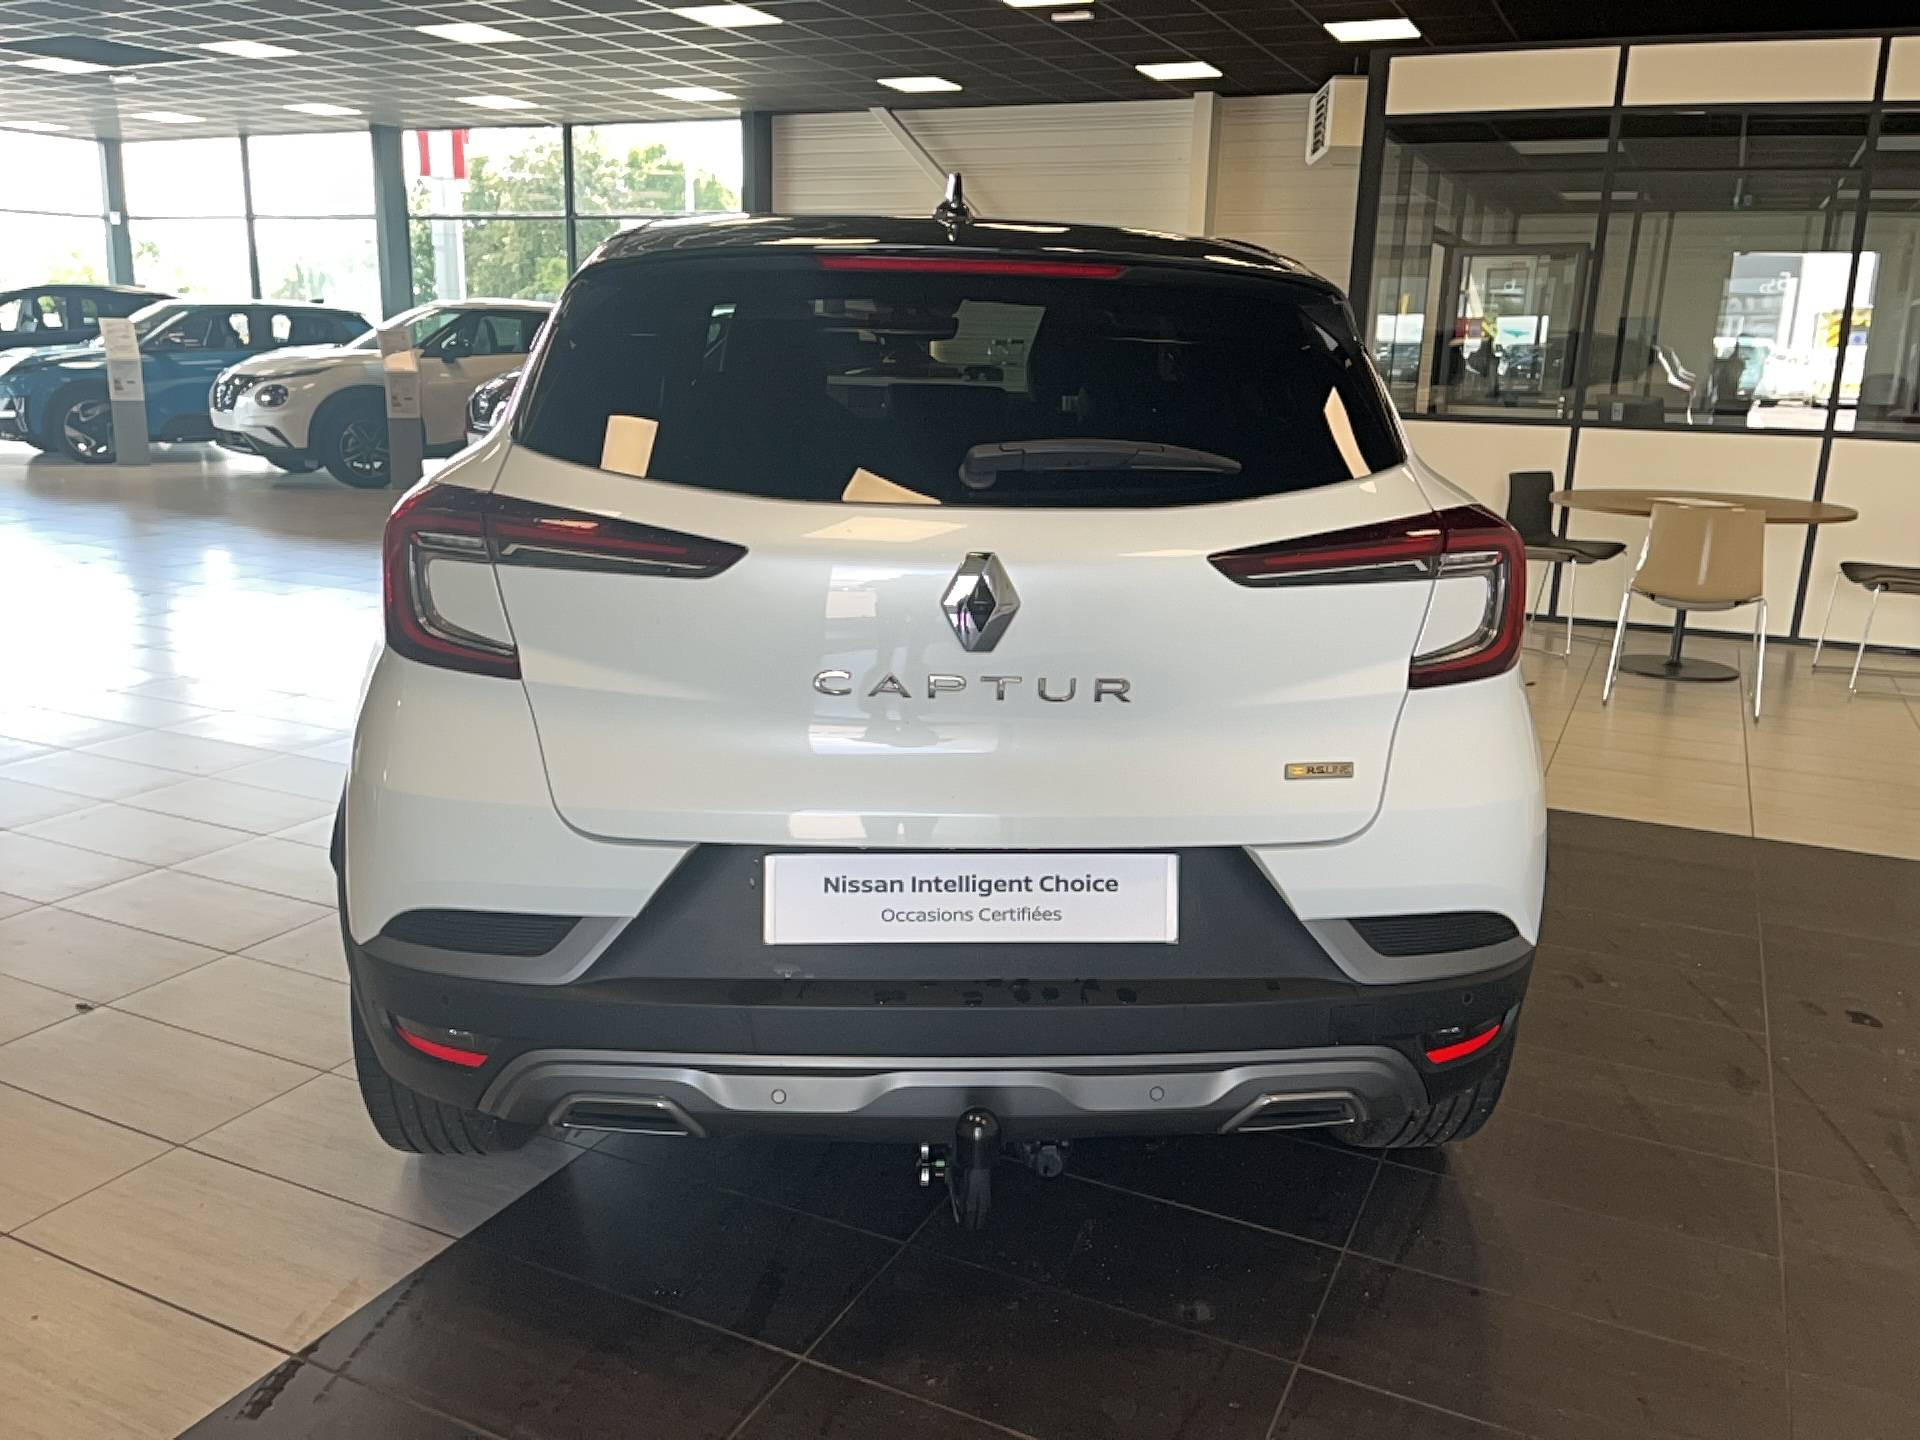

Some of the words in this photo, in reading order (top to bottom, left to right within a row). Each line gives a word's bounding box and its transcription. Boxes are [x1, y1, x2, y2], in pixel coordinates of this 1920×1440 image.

[812, 670, 1131, 703] CAPTUR
[823, 875, 904, 893] Nissan
[911, 874, 1033, 897] Intelligent
[1038, 874, 1119, 893] Choice
[881, 907, 973, 923] Occasions
[978, 906, 1063, 922] Certifiées
